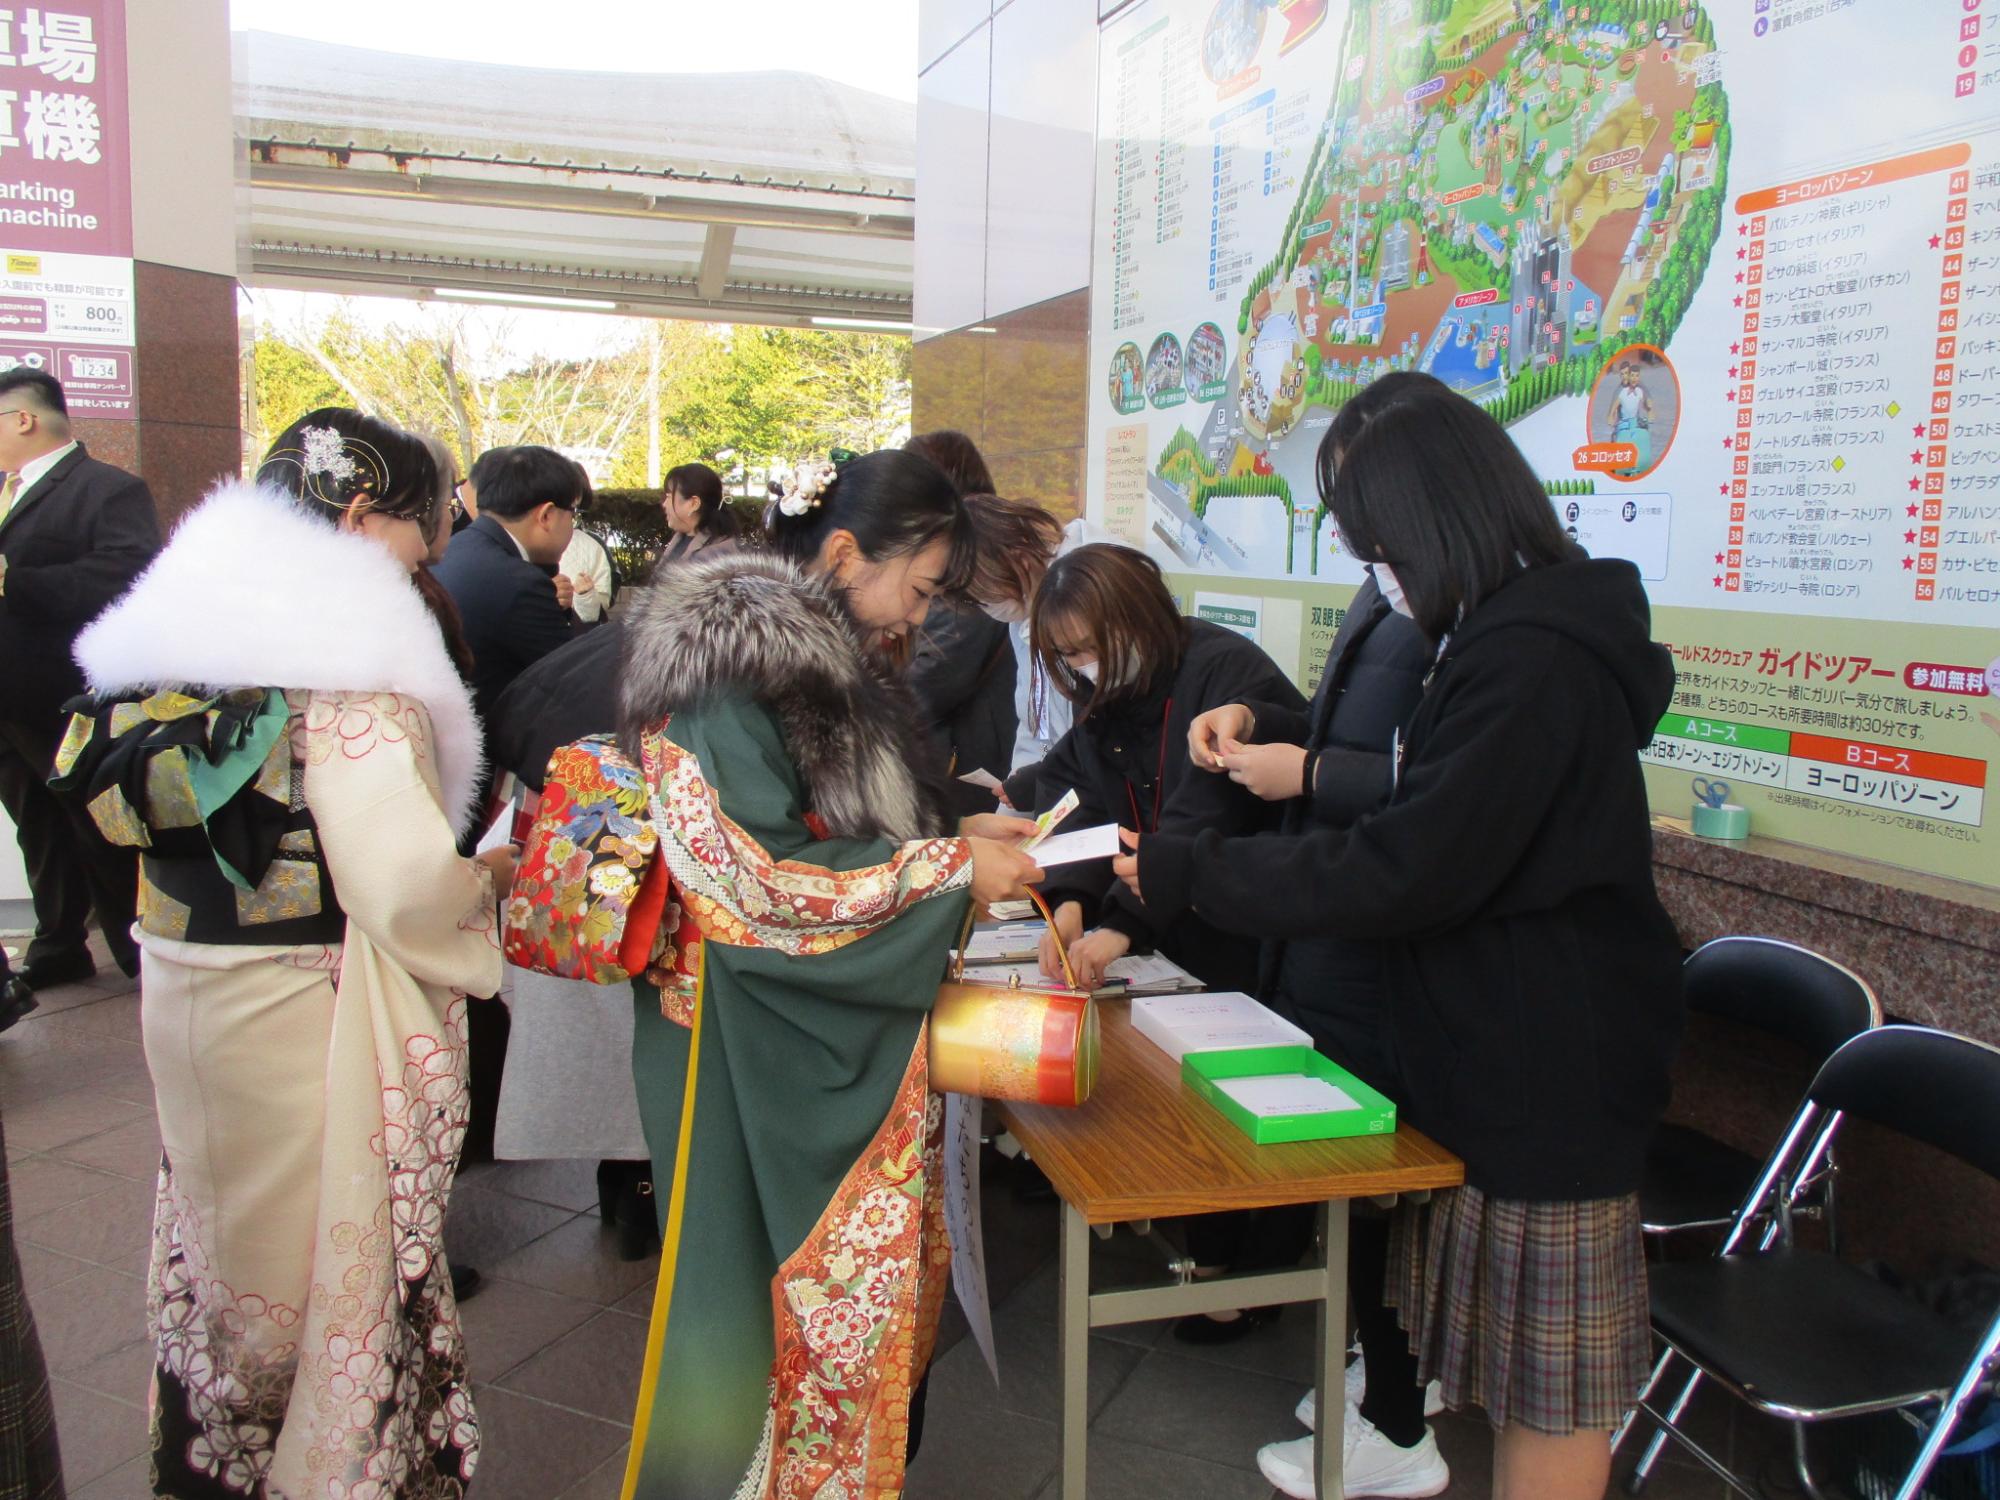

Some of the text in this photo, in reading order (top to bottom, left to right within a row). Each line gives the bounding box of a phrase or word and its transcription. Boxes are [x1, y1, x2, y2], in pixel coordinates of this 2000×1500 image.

[0, 7, 98, 83] 場
[0, 90, 101, 165] 機
[1775, 169, 1874, 204] ヨーロッパゾーン
[0, 207, 98, 230] machine
[0, 279, 126, 297] 入園前でも精算が可能です
[1762, 303, 1872, 329] ミラノ大聖堂(イタリア)
[1759, 352, 1880, 377] シャンボール城(フランス)
[1757, 378, 1890, 403] ヴェルサイユ宮殿(フランス)
[1756, 404, 1886, 427] サクレクール寺院(フランス)
[1753, 430, 1885, 450] ノートルダム寺院(フランス)
[1577, 450, 1633, 464] 26 コロッセオ
[1752, 458, 1831, 475] 凱旋門(フランス)
[1750, 482, 1857, 498] エッフェル塔(フランス)
[1746, 532, 1872, 546] ボルグンド教会堂(ノルウェー)
[1941, 557, 2000, 573] カサ・ビセ
[1757, 648, 1896, 684] ガイドツアー
[1912, 667, 1985, 693] 参加無料
[1685, 720, 1737, 742] Aコース
[1846, 745, 1911, 772] Bコース
[1806, 767, 1960, 811] ヨーロッパゾーン
